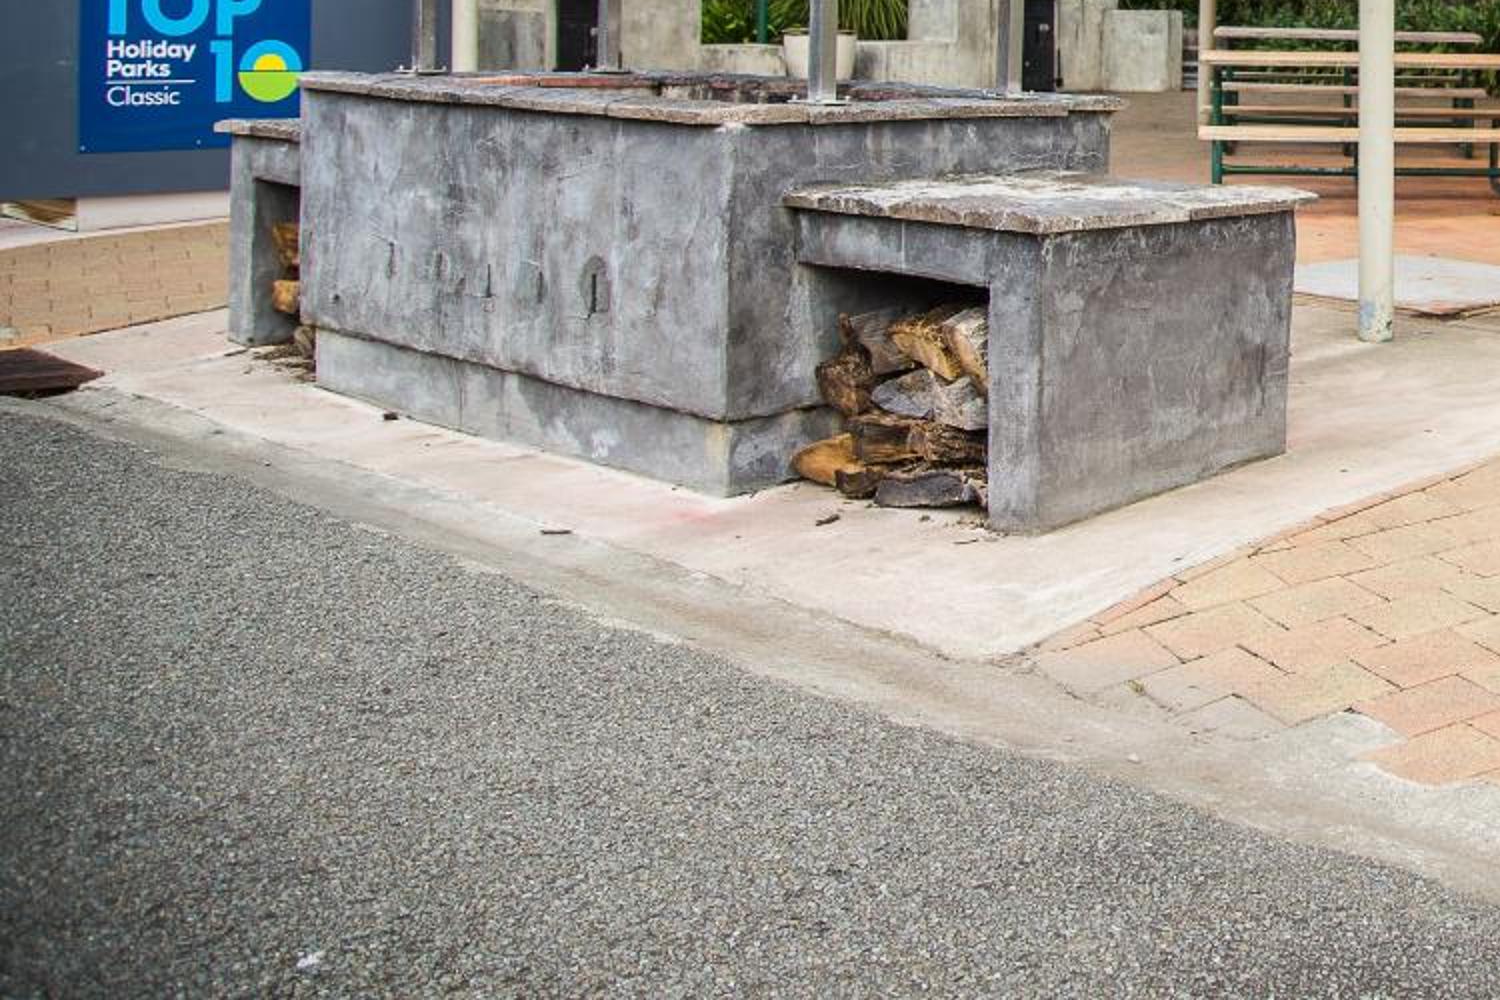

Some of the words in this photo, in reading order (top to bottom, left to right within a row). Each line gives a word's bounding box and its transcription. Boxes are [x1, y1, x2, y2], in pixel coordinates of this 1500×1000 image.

[106, 40, 197, 62] Holiday
[106, 60, 171, 78] Parks
[210, 39, 303, 103] 10
[106, 86, 181, 107] Classic
